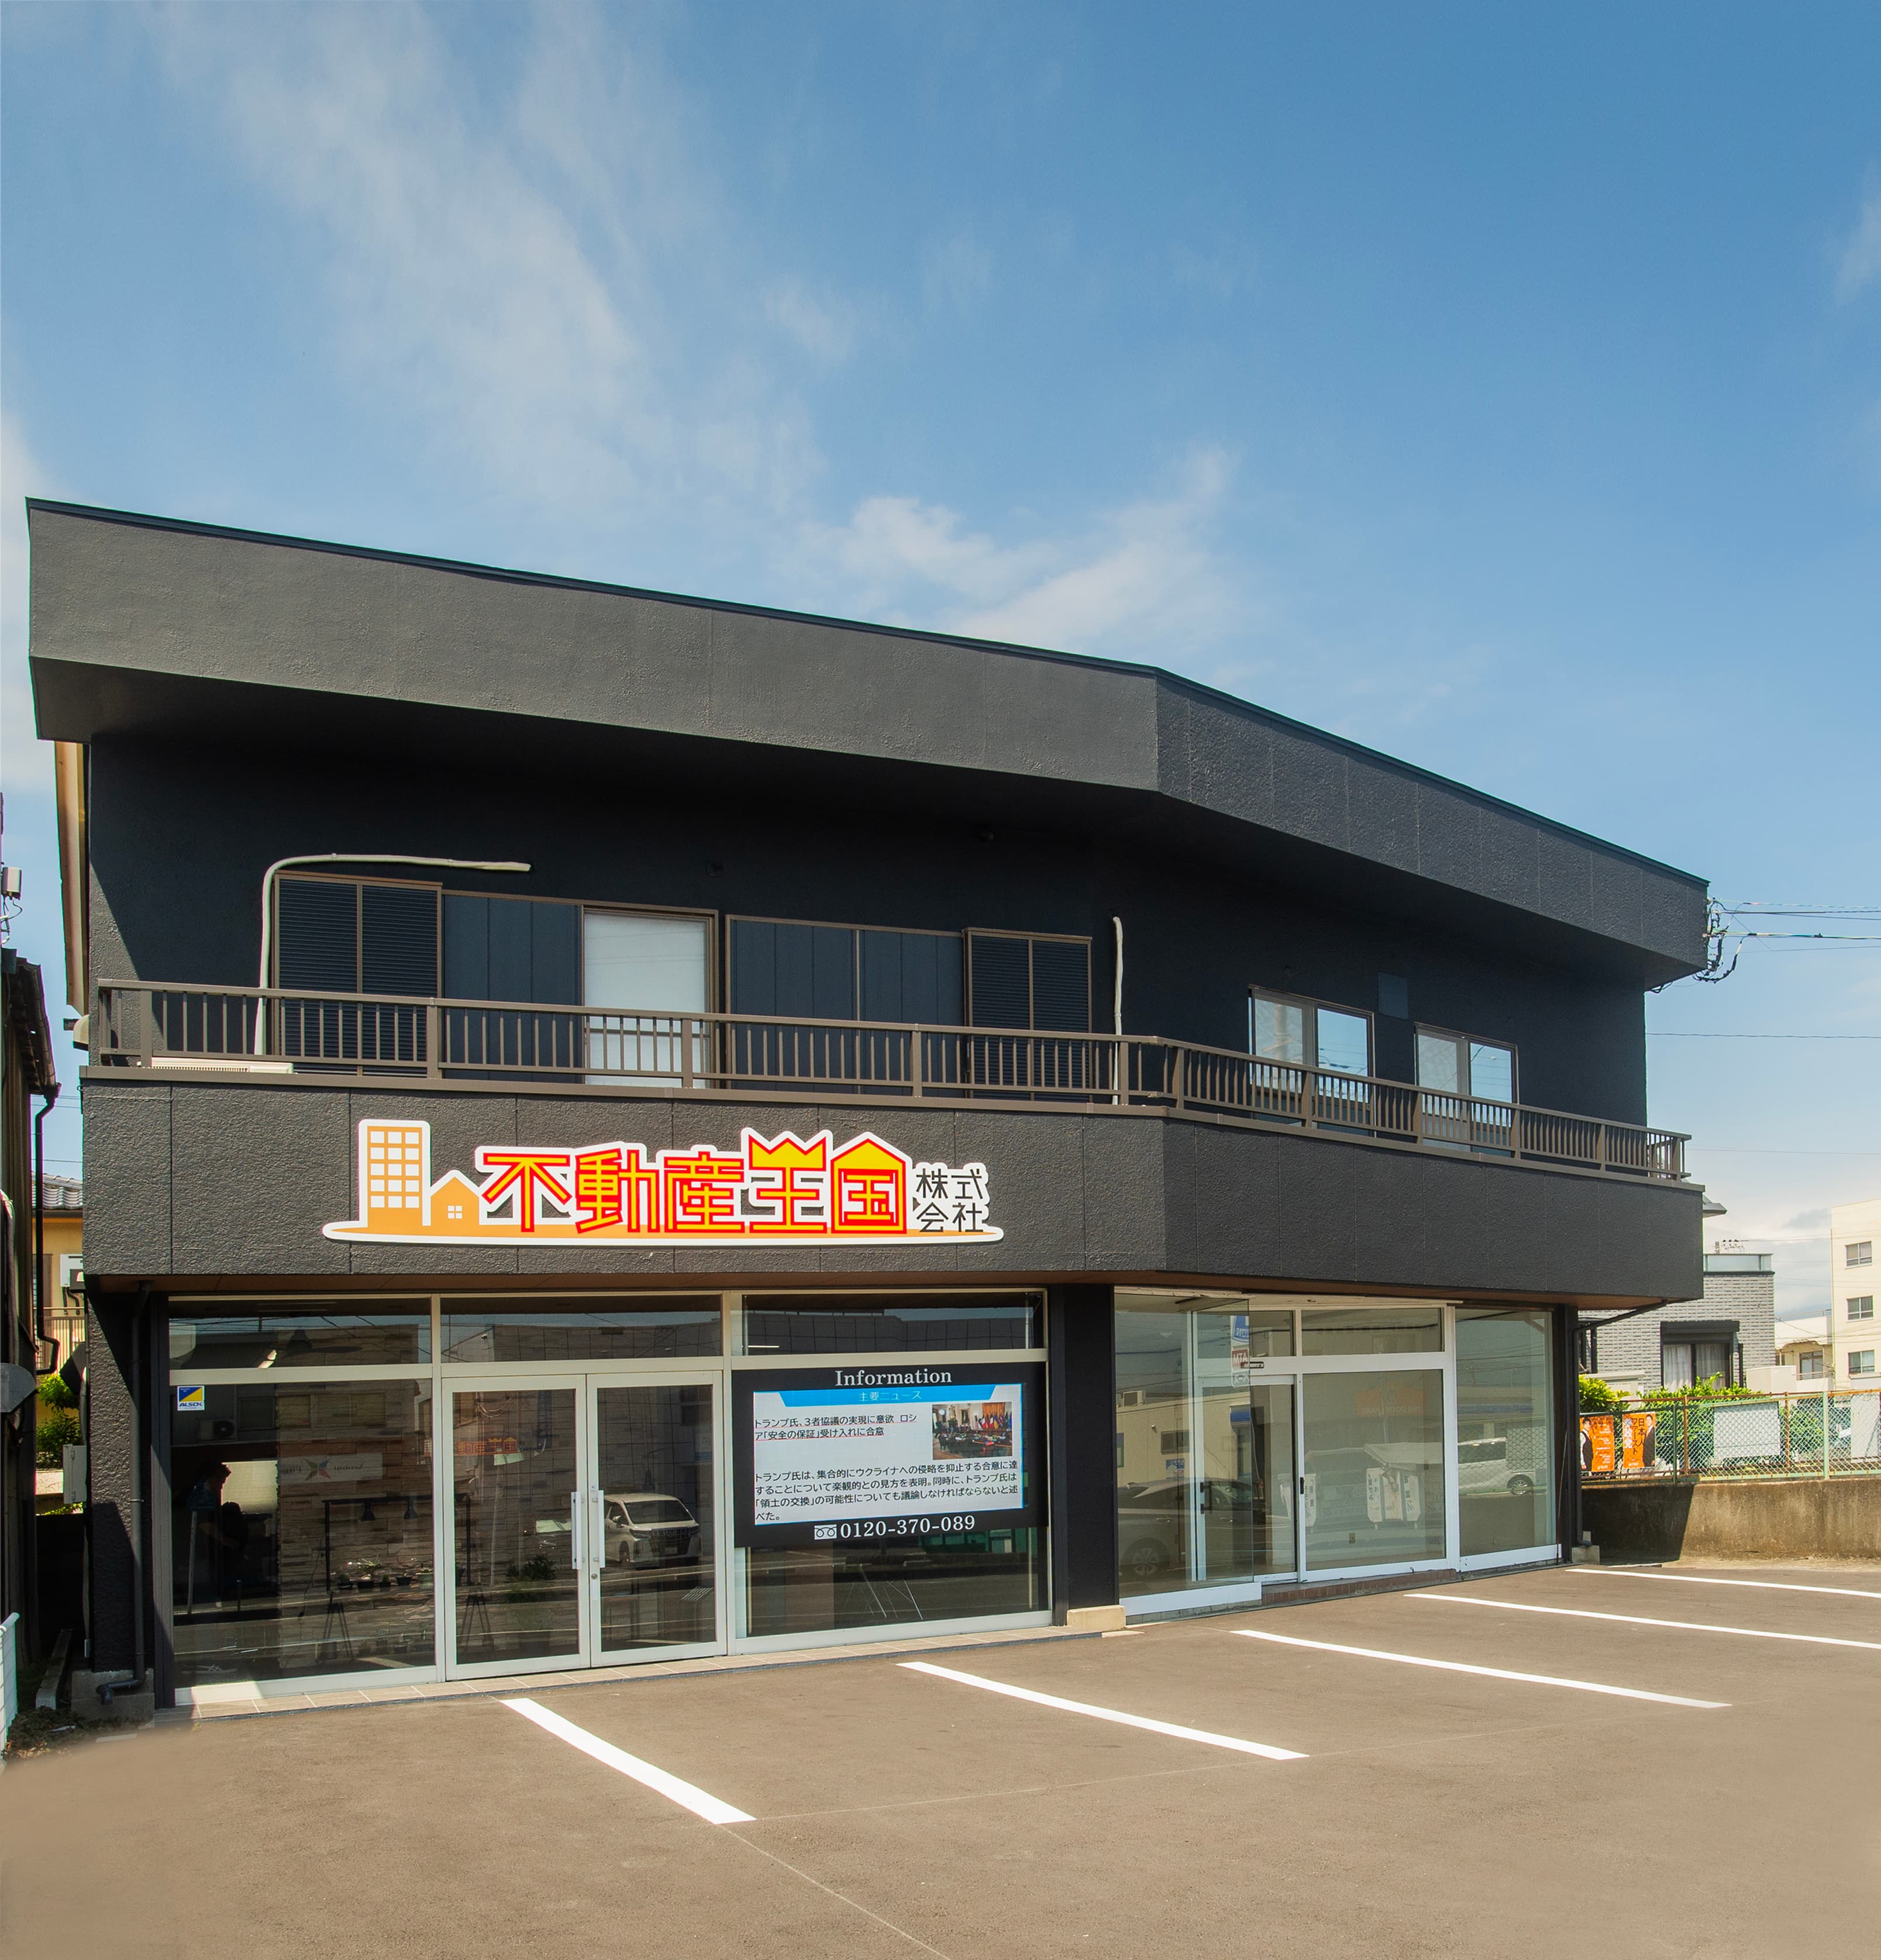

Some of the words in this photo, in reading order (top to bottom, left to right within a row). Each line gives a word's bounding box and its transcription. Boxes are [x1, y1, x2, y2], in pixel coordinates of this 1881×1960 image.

[481, 1135, 907, 1234] 不動産王国
[916, 1168, 983, 1199] 株式
[916, 1202, 983, 1233] 会社
[835, 1369, 952, 1386] Information
[859, 1390, 922, 1402] 主要ニュース
[900, 1414, 917, 1422] ロシ
[756, 1511, 780, 1521] べた。
[840, 1515, 975, 1538] 0120-370-089
